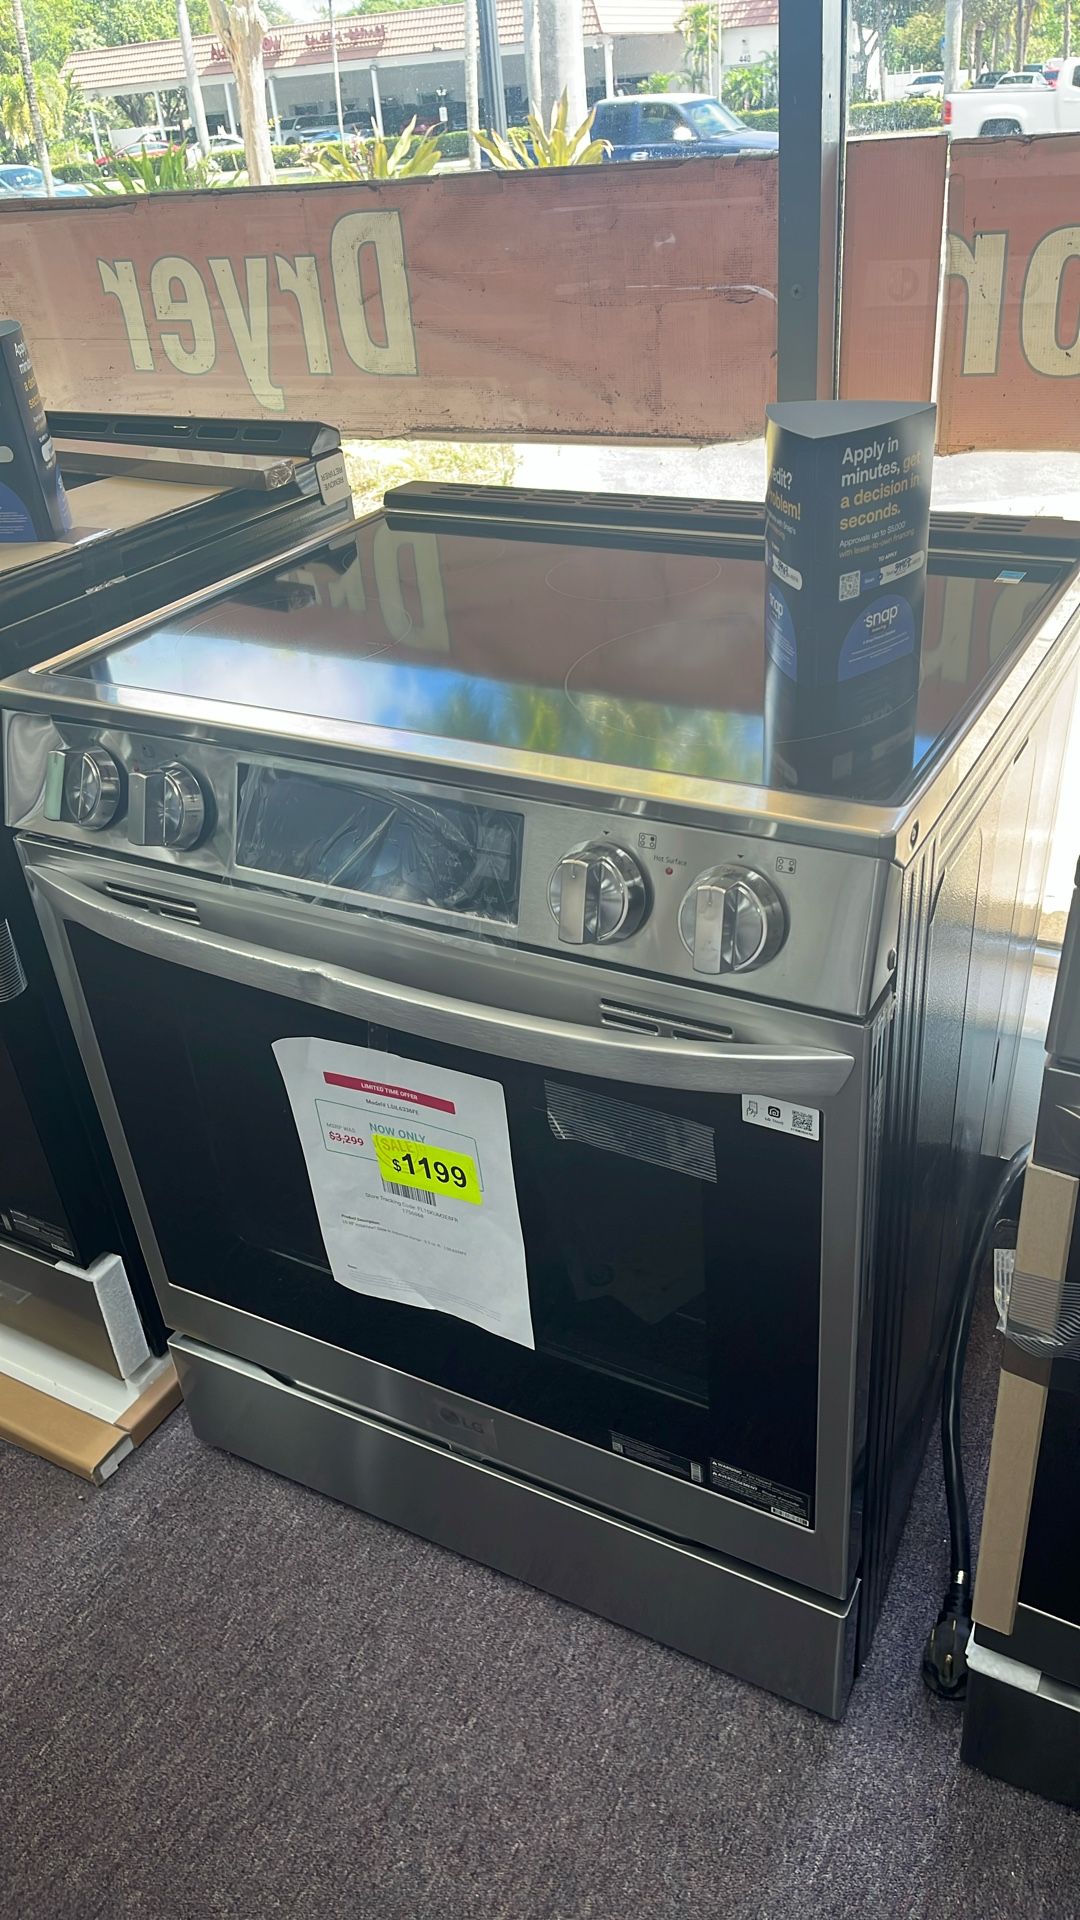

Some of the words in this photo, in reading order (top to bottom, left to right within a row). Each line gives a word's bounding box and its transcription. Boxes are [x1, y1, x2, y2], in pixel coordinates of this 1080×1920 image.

[842, 441, 885, 466] Apply
[887, 436, 899, 453] in
[773, 467, 793, 490] edit?
[841, 461, 900, 487] minutes,
[903, 450, 921, 473] get
[840, 496, 850, 509] a
[854, 480, 908, 506] decision
[911, 472, 920, 488] in
[768, 491, 800, 520] roblem!
[840, 502, 901, 530] seconds.
[865, 605, 898, 628] snap
[361, 1082, 384, 1093] LIMITED
[384, 1088, 399, 1096] TIME
[400, 1091, 418, 1100] OFFER
[328, 1131, 364, 1146] $3,299
[369, 1122, 395, 1136] NOW
[399, 1130, 426, 1144] ONLY
[392, 1153, 467, 1188] $1199
